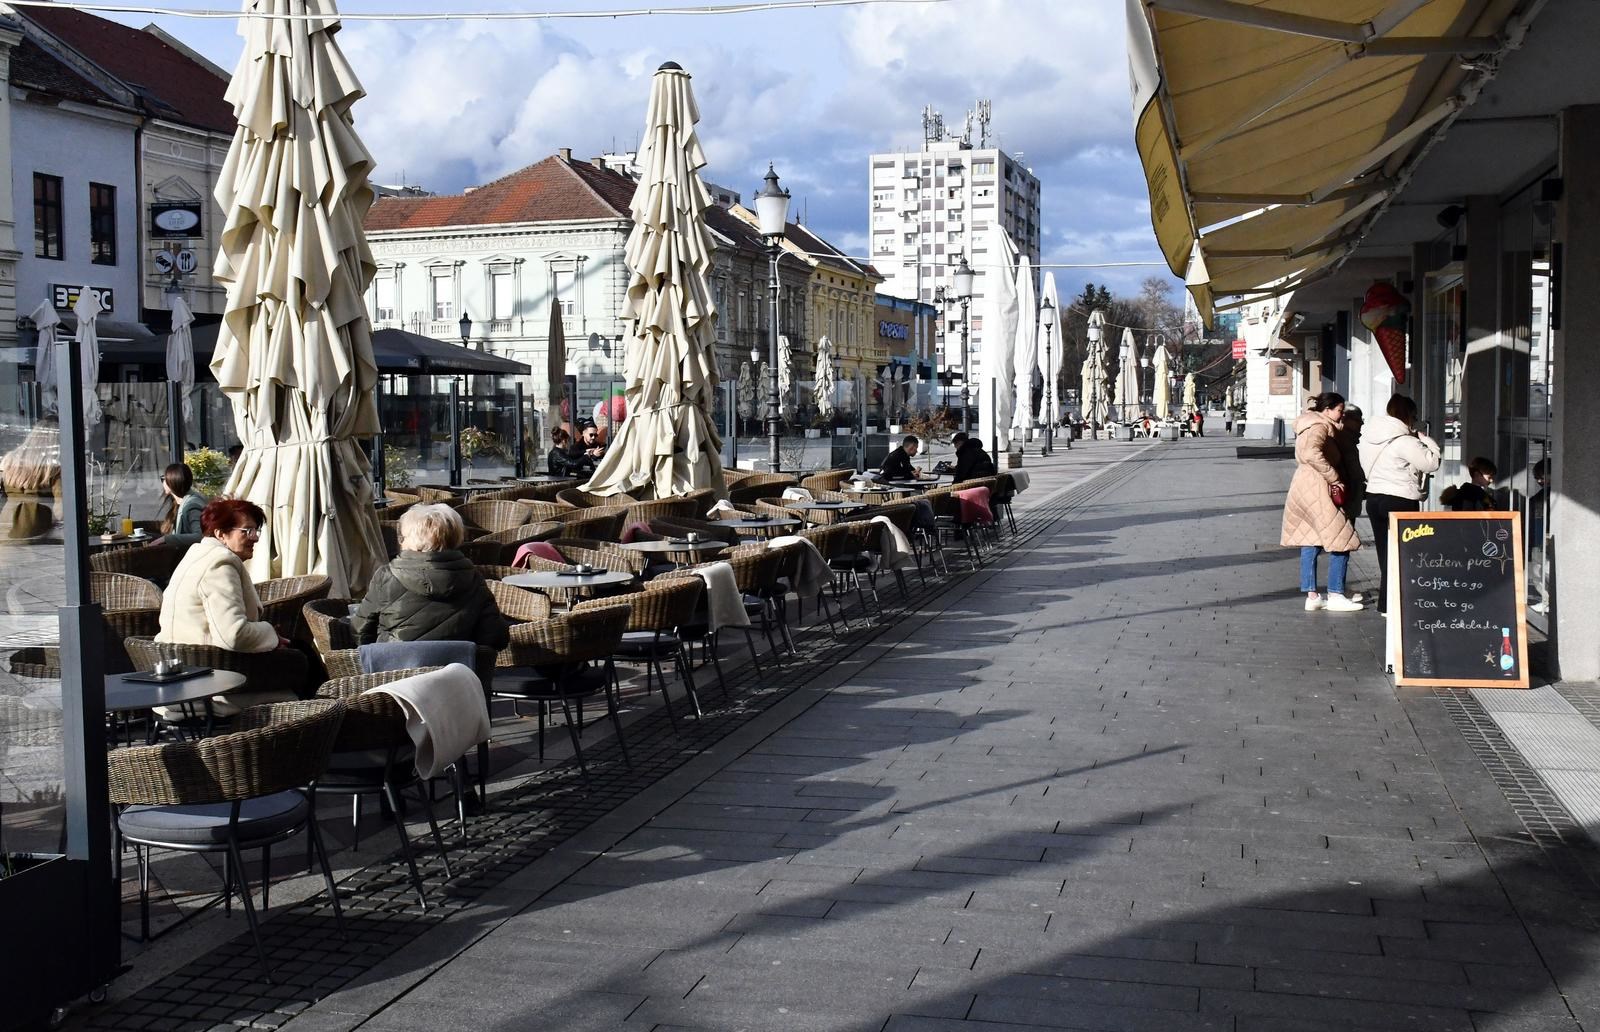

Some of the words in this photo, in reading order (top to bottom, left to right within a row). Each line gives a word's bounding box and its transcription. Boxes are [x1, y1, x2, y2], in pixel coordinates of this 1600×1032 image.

[1417, 576, 1450, 591] Coffee
[1453, 579, 1468, 588] to
[1469, 582, 1484, 591] go
[1417, 598, 1438, 609] Tea
[1444, 598, 1457, 608] to
[1460, 602, 1475, 612] go
[1417, 619, 1447, 634] Topla
